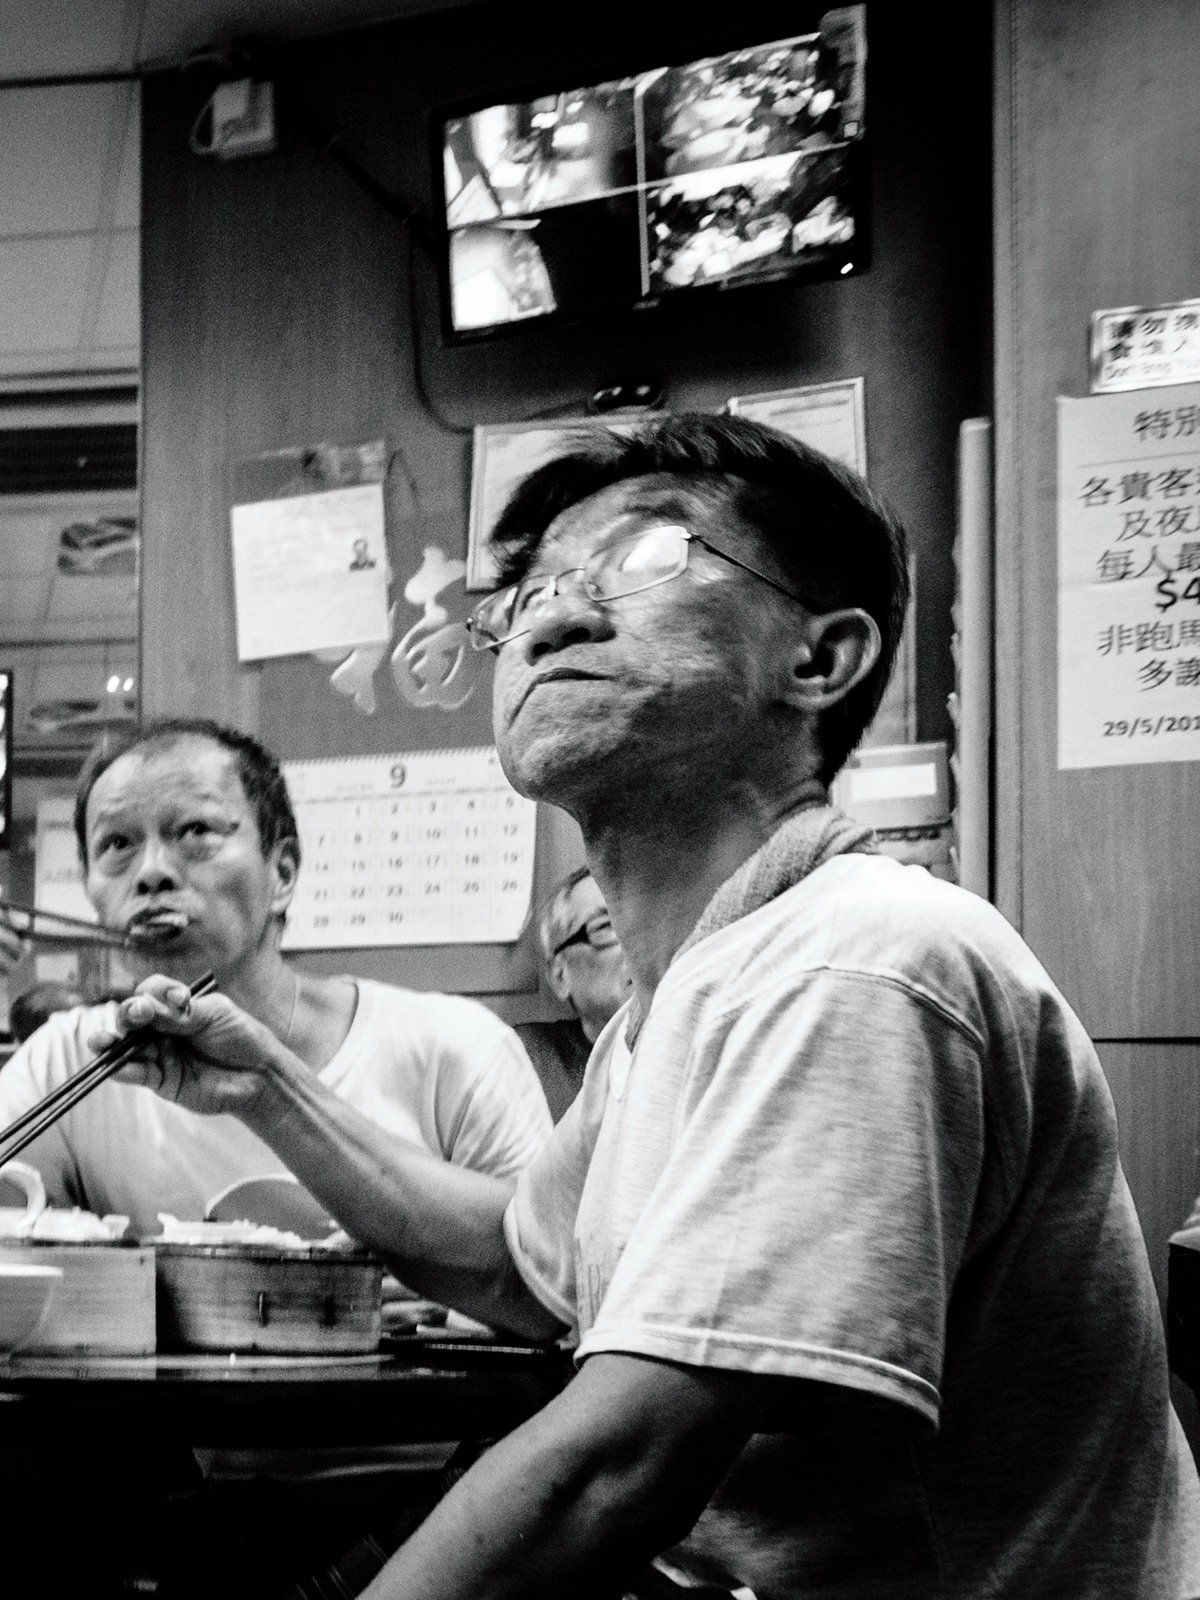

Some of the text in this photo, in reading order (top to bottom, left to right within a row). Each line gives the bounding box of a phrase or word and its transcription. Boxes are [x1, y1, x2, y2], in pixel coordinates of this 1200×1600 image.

[1133, 405, 1200, 442] 特別
[1078, 467, 1200, 508] 各貴客
[1115, 504, 1200, 542] 及夜
[389, 763, 407, 789] 9
